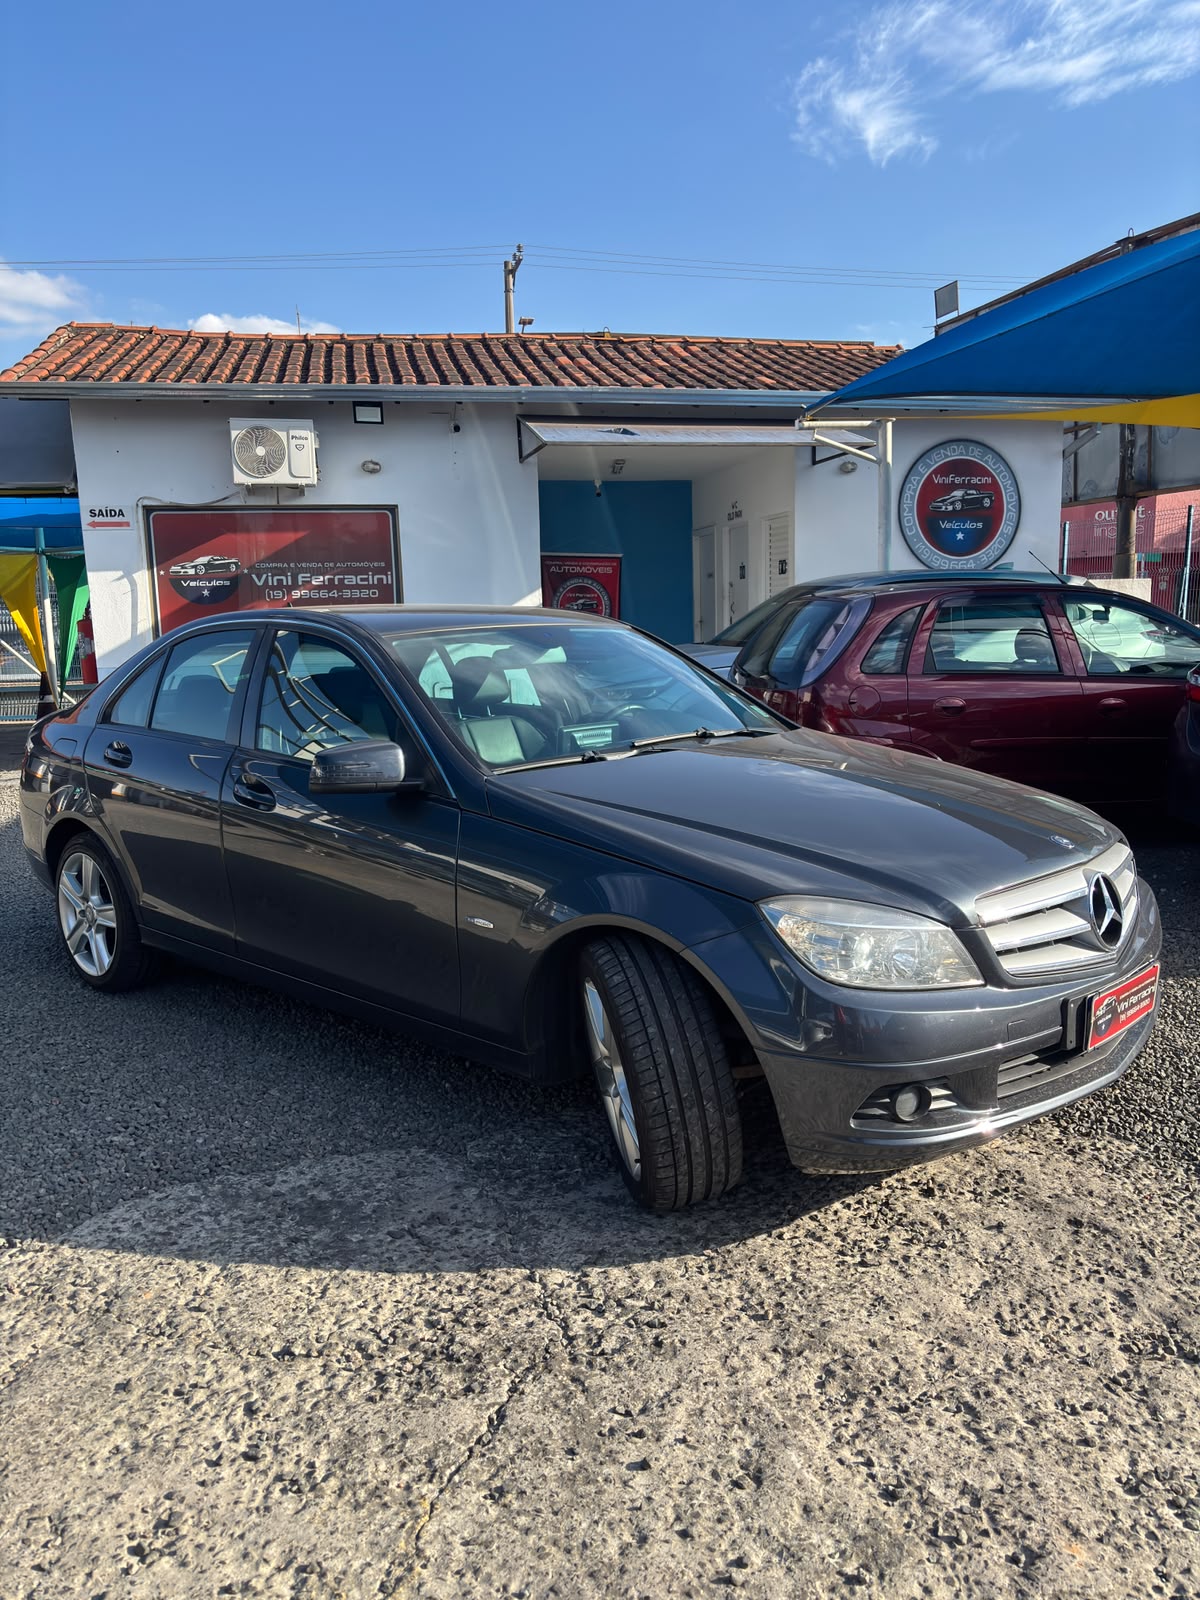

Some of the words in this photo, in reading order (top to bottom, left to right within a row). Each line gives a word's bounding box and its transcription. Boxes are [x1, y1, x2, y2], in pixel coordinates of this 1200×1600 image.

[904, 474, 920, 536] COMPRA
[918, 464, 928, 474] E
[926, 445, 966, 466] VENDA
[969, 446, 984, 458] DE
[983, 455, 1017, 535] AUTOMÓVEIS
[89, 506, 125, 518] SAÍDA
[939, 520, 984, 529] Veículos
[251, 572, 292, 586] Vini
[298, 572, 392, 585] Ferracini
[266, 588, 287, 602] (19)
[292, 589, 378, 599] 99664-3320
